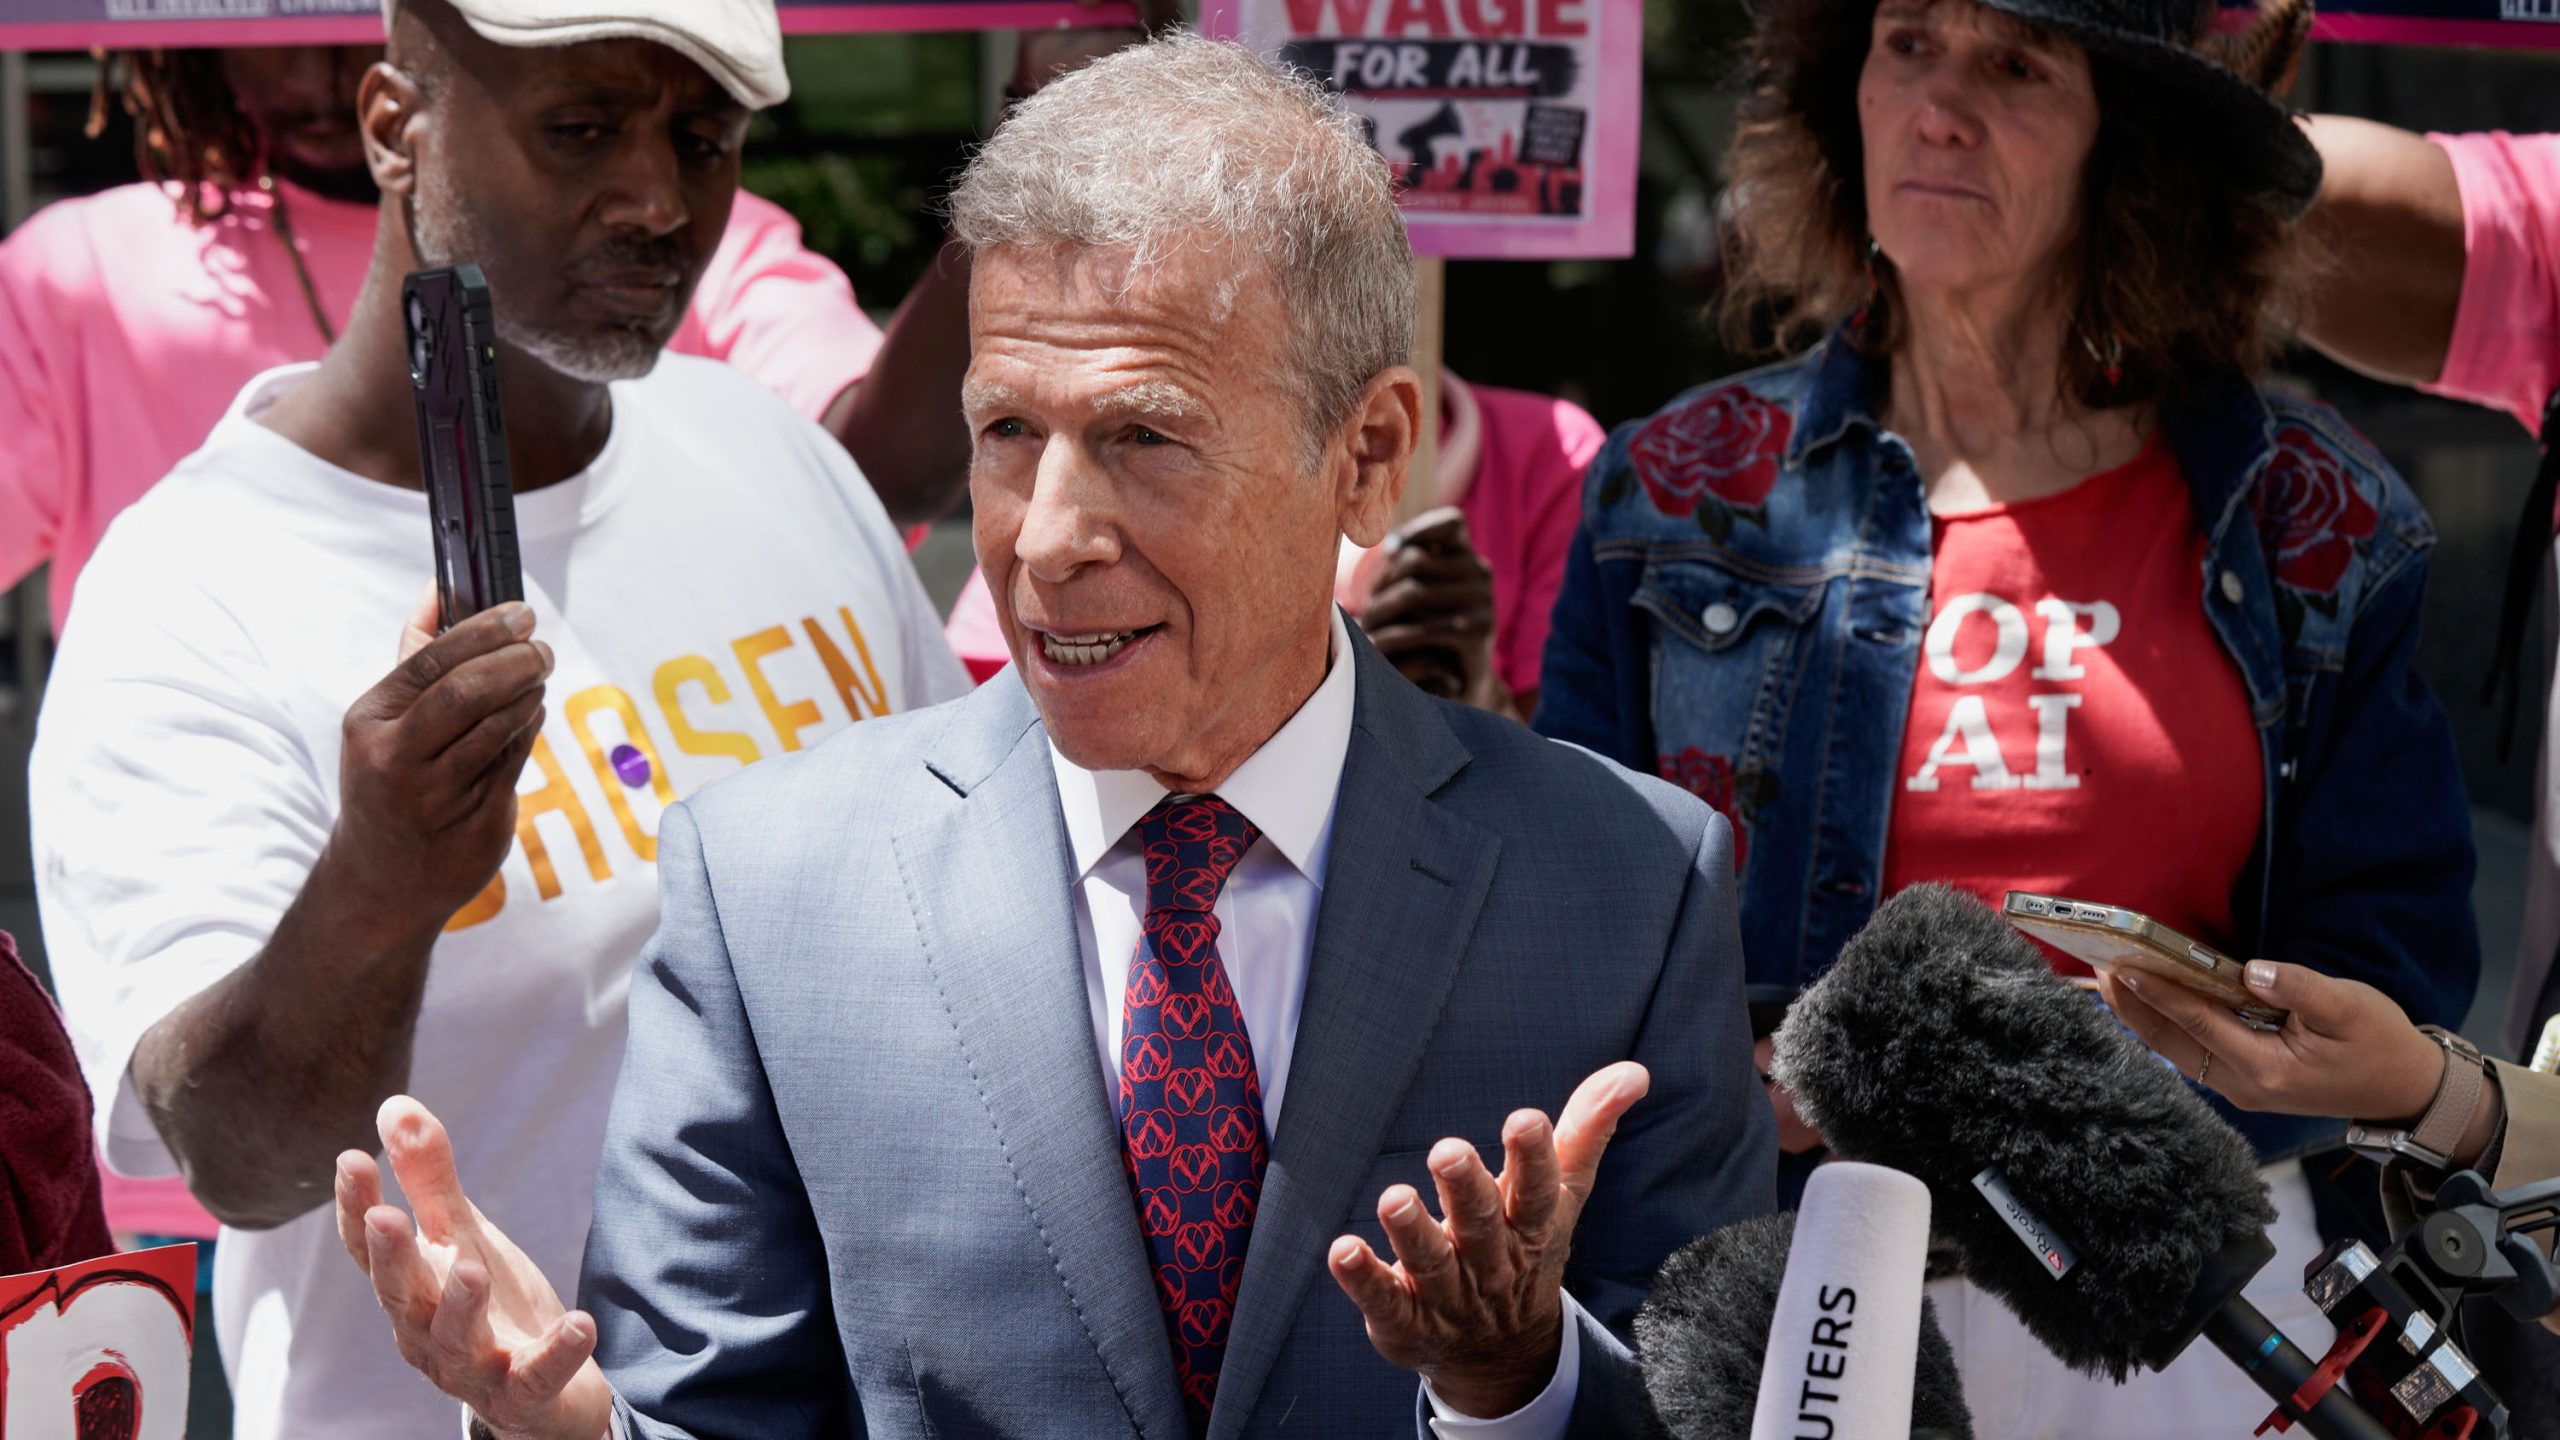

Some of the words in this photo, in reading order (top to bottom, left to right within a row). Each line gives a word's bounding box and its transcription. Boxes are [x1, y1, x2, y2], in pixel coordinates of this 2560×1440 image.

[1284, 0, 1588, 38] WAGE
[1333, 44, 1429, 87] FOR
[1447, 44, 1541, 86] ALL
[1925, 591, 2121, 684] OP
[442, 606, 893, 933] HOSEN
[1906, 694, 2082, 792] AI
[2006, 1201, 2052, 1255] Rycote
[1794, 1284, 1857, 1440] UTERS
